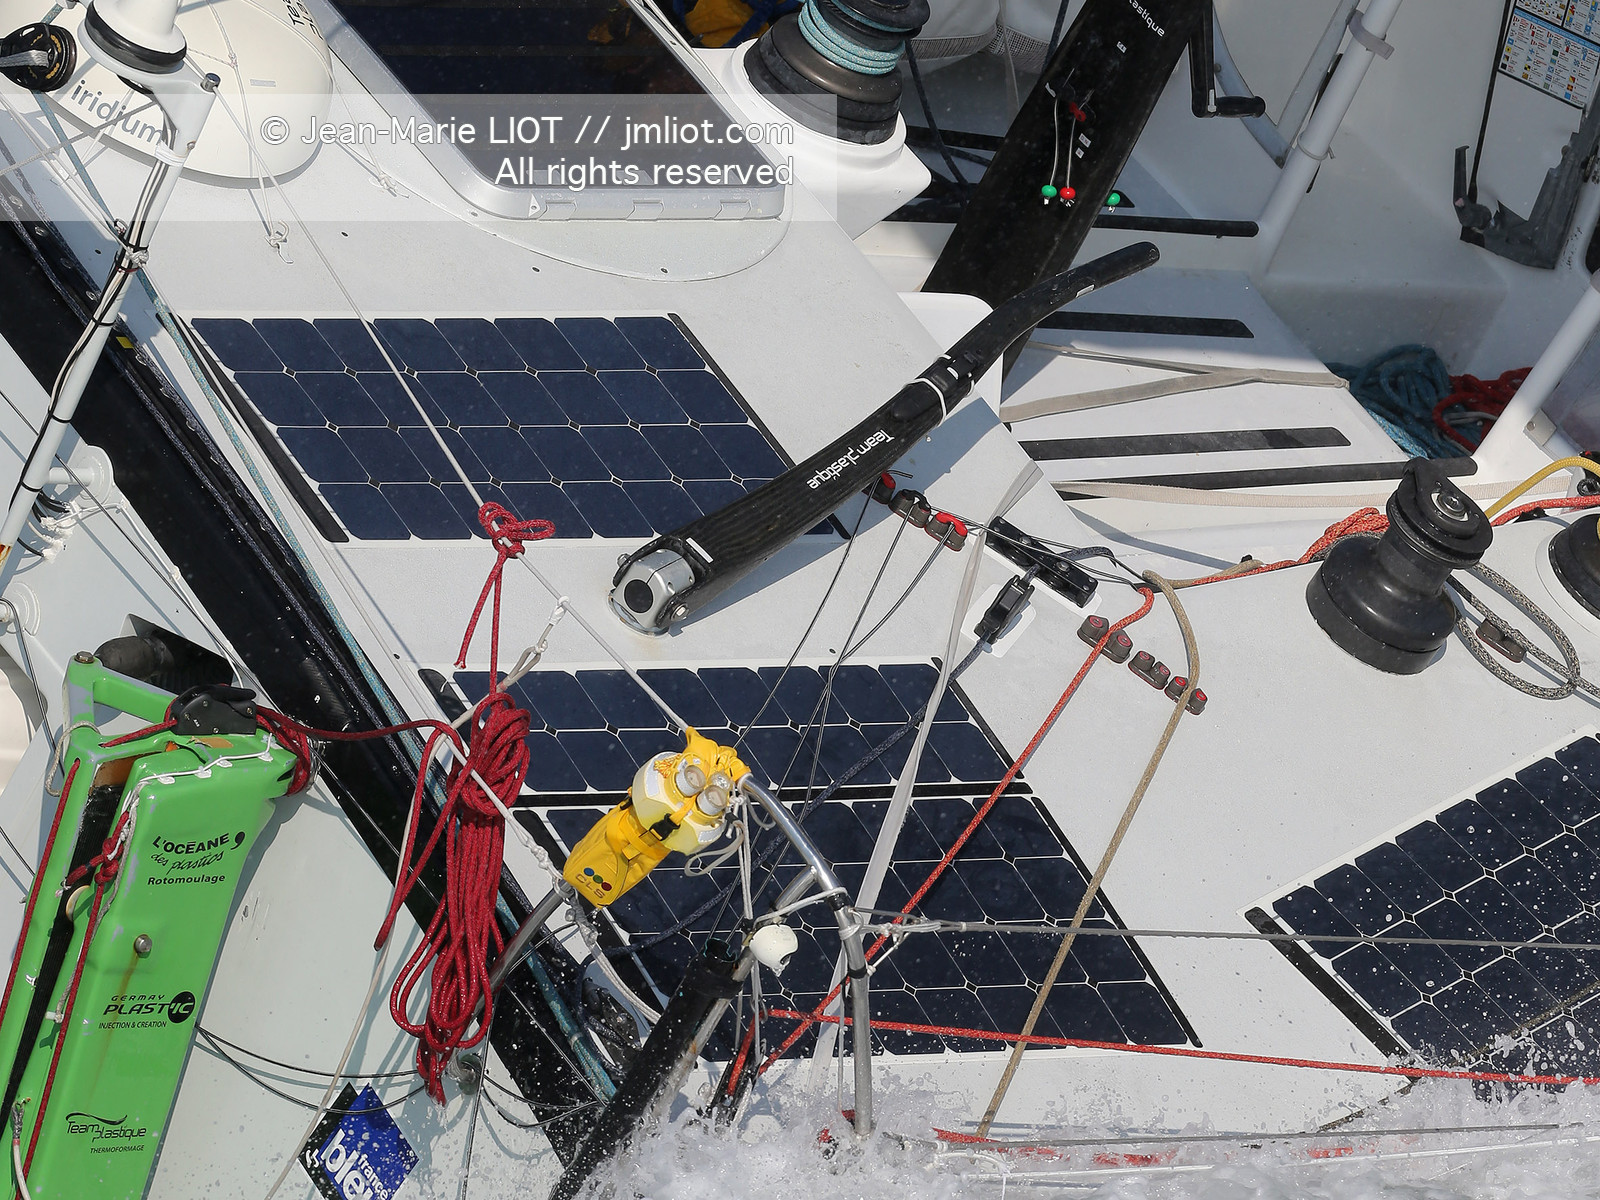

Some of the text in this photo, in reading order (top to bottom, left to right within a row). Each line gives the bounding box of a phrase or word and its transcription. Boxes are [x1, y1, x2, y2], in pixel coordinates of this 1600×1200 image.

[71, 80, 162, 145] iridium
[807, 429, 895, 489] Team plastique
[147, 875, 225, 885] Rotomoulage
[576, 873, 605, 898] CLS
[111, 994, 165, 1002] GERMAY
[67, 1121, 99, 1134] Team
[92, 1126, 147, 1142] plastique
[90, 1145, 144, 1154] THERMOFORMAGE
[321, 1128, 373, 1200] ble
[358, 1154, 388, 1200] france
